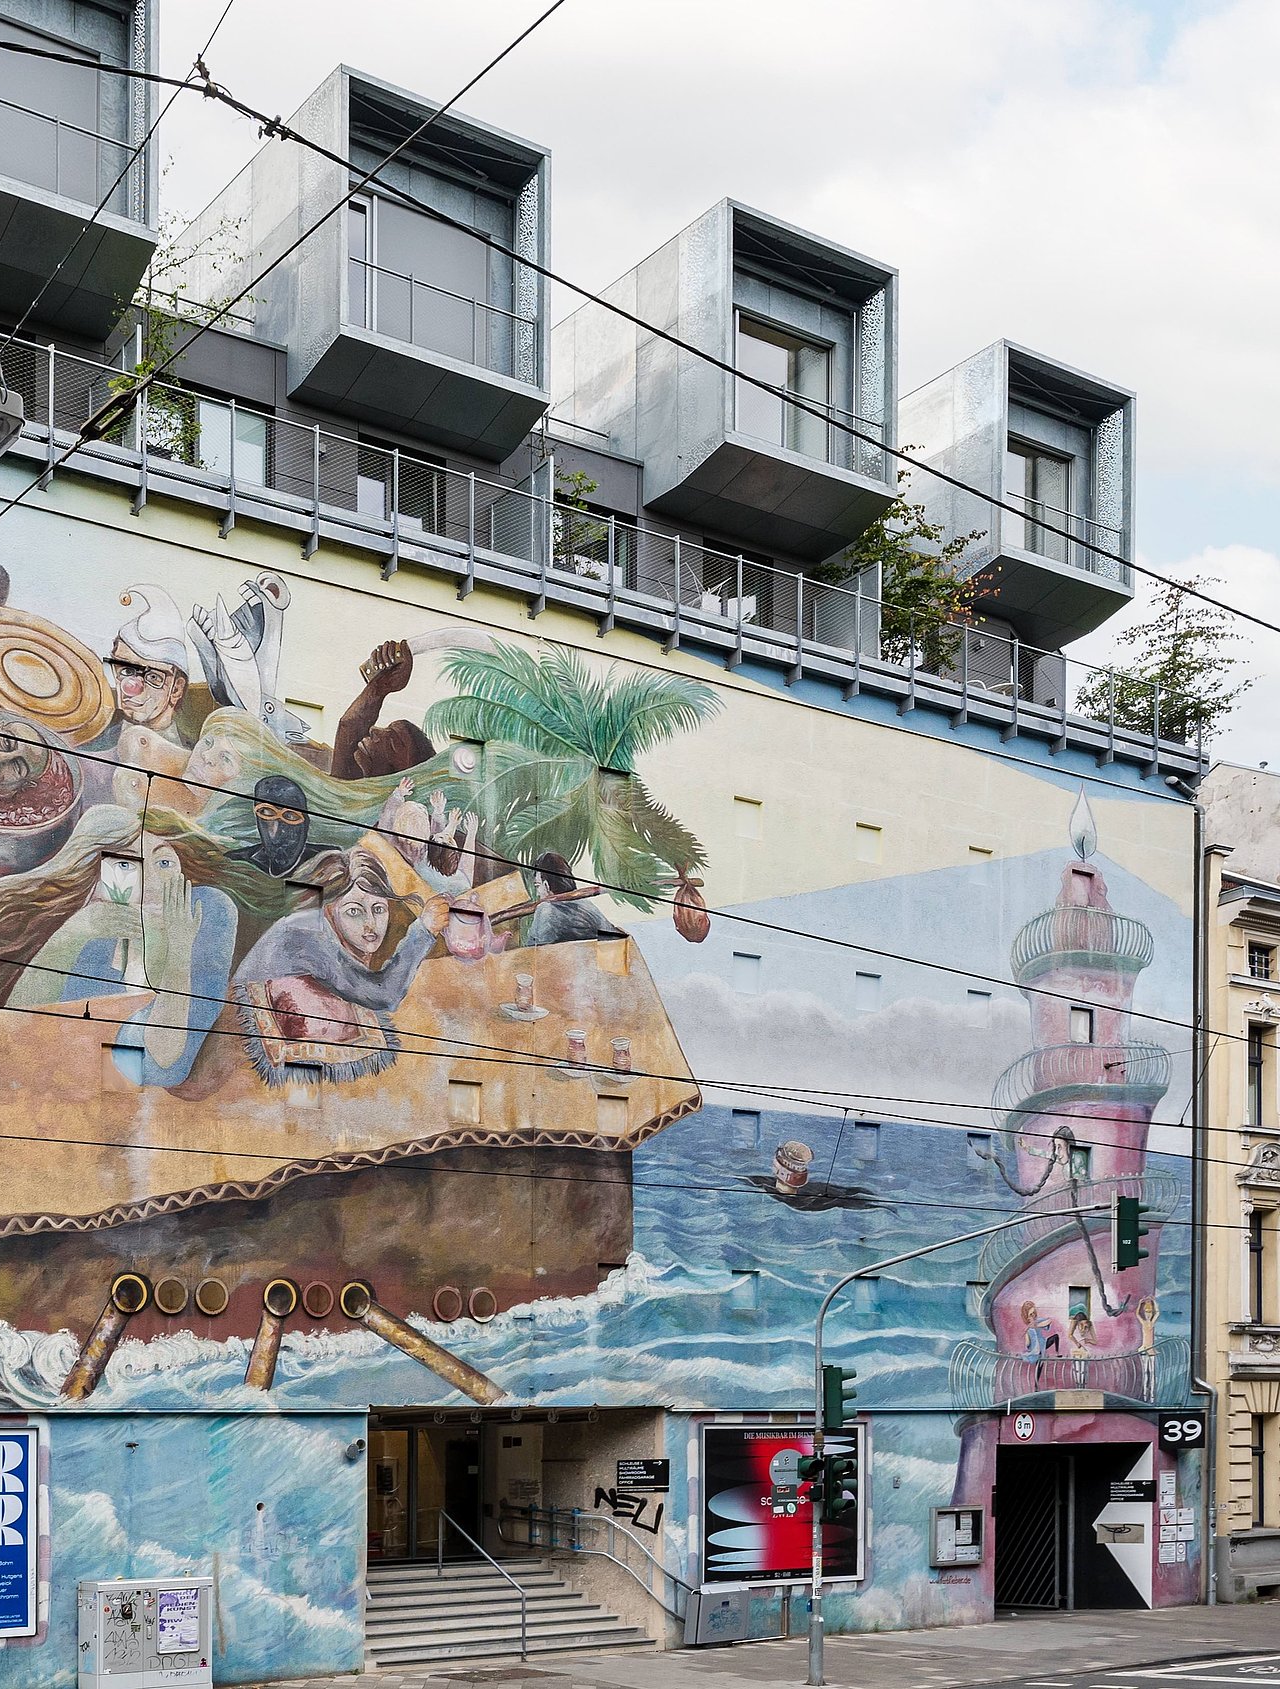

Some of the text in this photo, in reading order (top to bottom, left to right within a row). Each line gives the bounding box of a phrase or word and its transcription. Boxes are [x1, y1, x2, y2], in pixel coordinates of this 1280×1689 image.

[1017, 1421, 1022, 1430] 3
[1163, 1419, 1202, 1442] 39
[743, 1432, 755, 1440] DIE
[788, 1431, 797, 1439] IM
[594, 1488, 663, 1534] NEU
